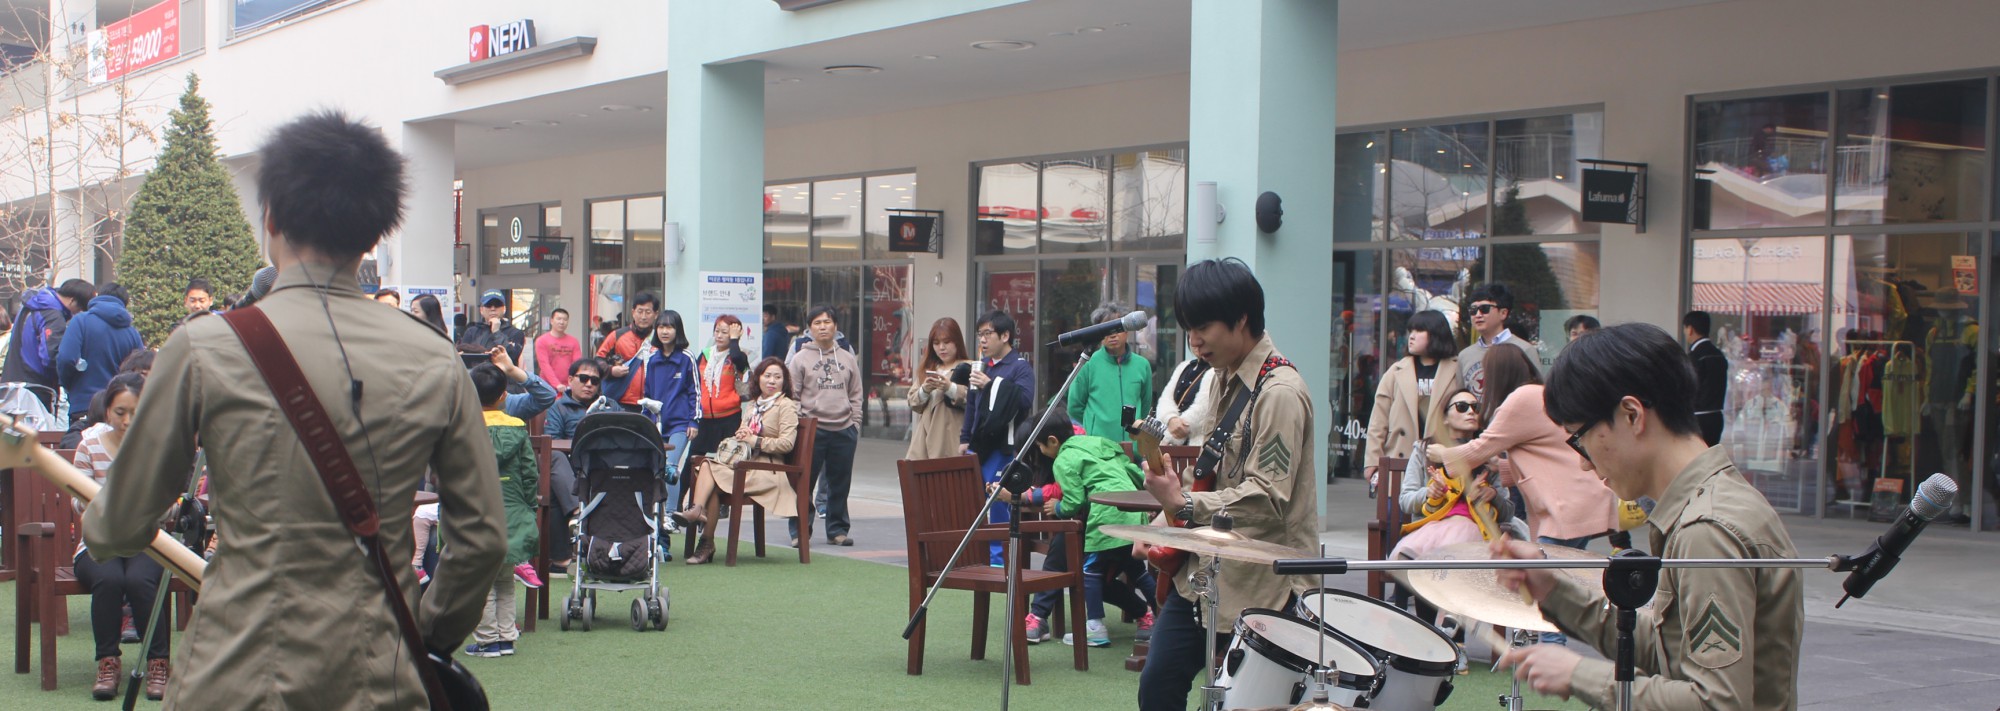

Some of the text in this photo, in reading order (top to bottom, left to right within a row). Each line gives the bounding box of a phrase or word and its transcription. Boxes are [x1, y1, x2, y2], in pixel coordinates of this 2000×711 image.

[129, 27, 162, 66] 59,000
[488, 19, 531, 57] NEPA
[1588, 190, 1617, 202] Lafuma
[991, 298, 1035, 314] SALE
